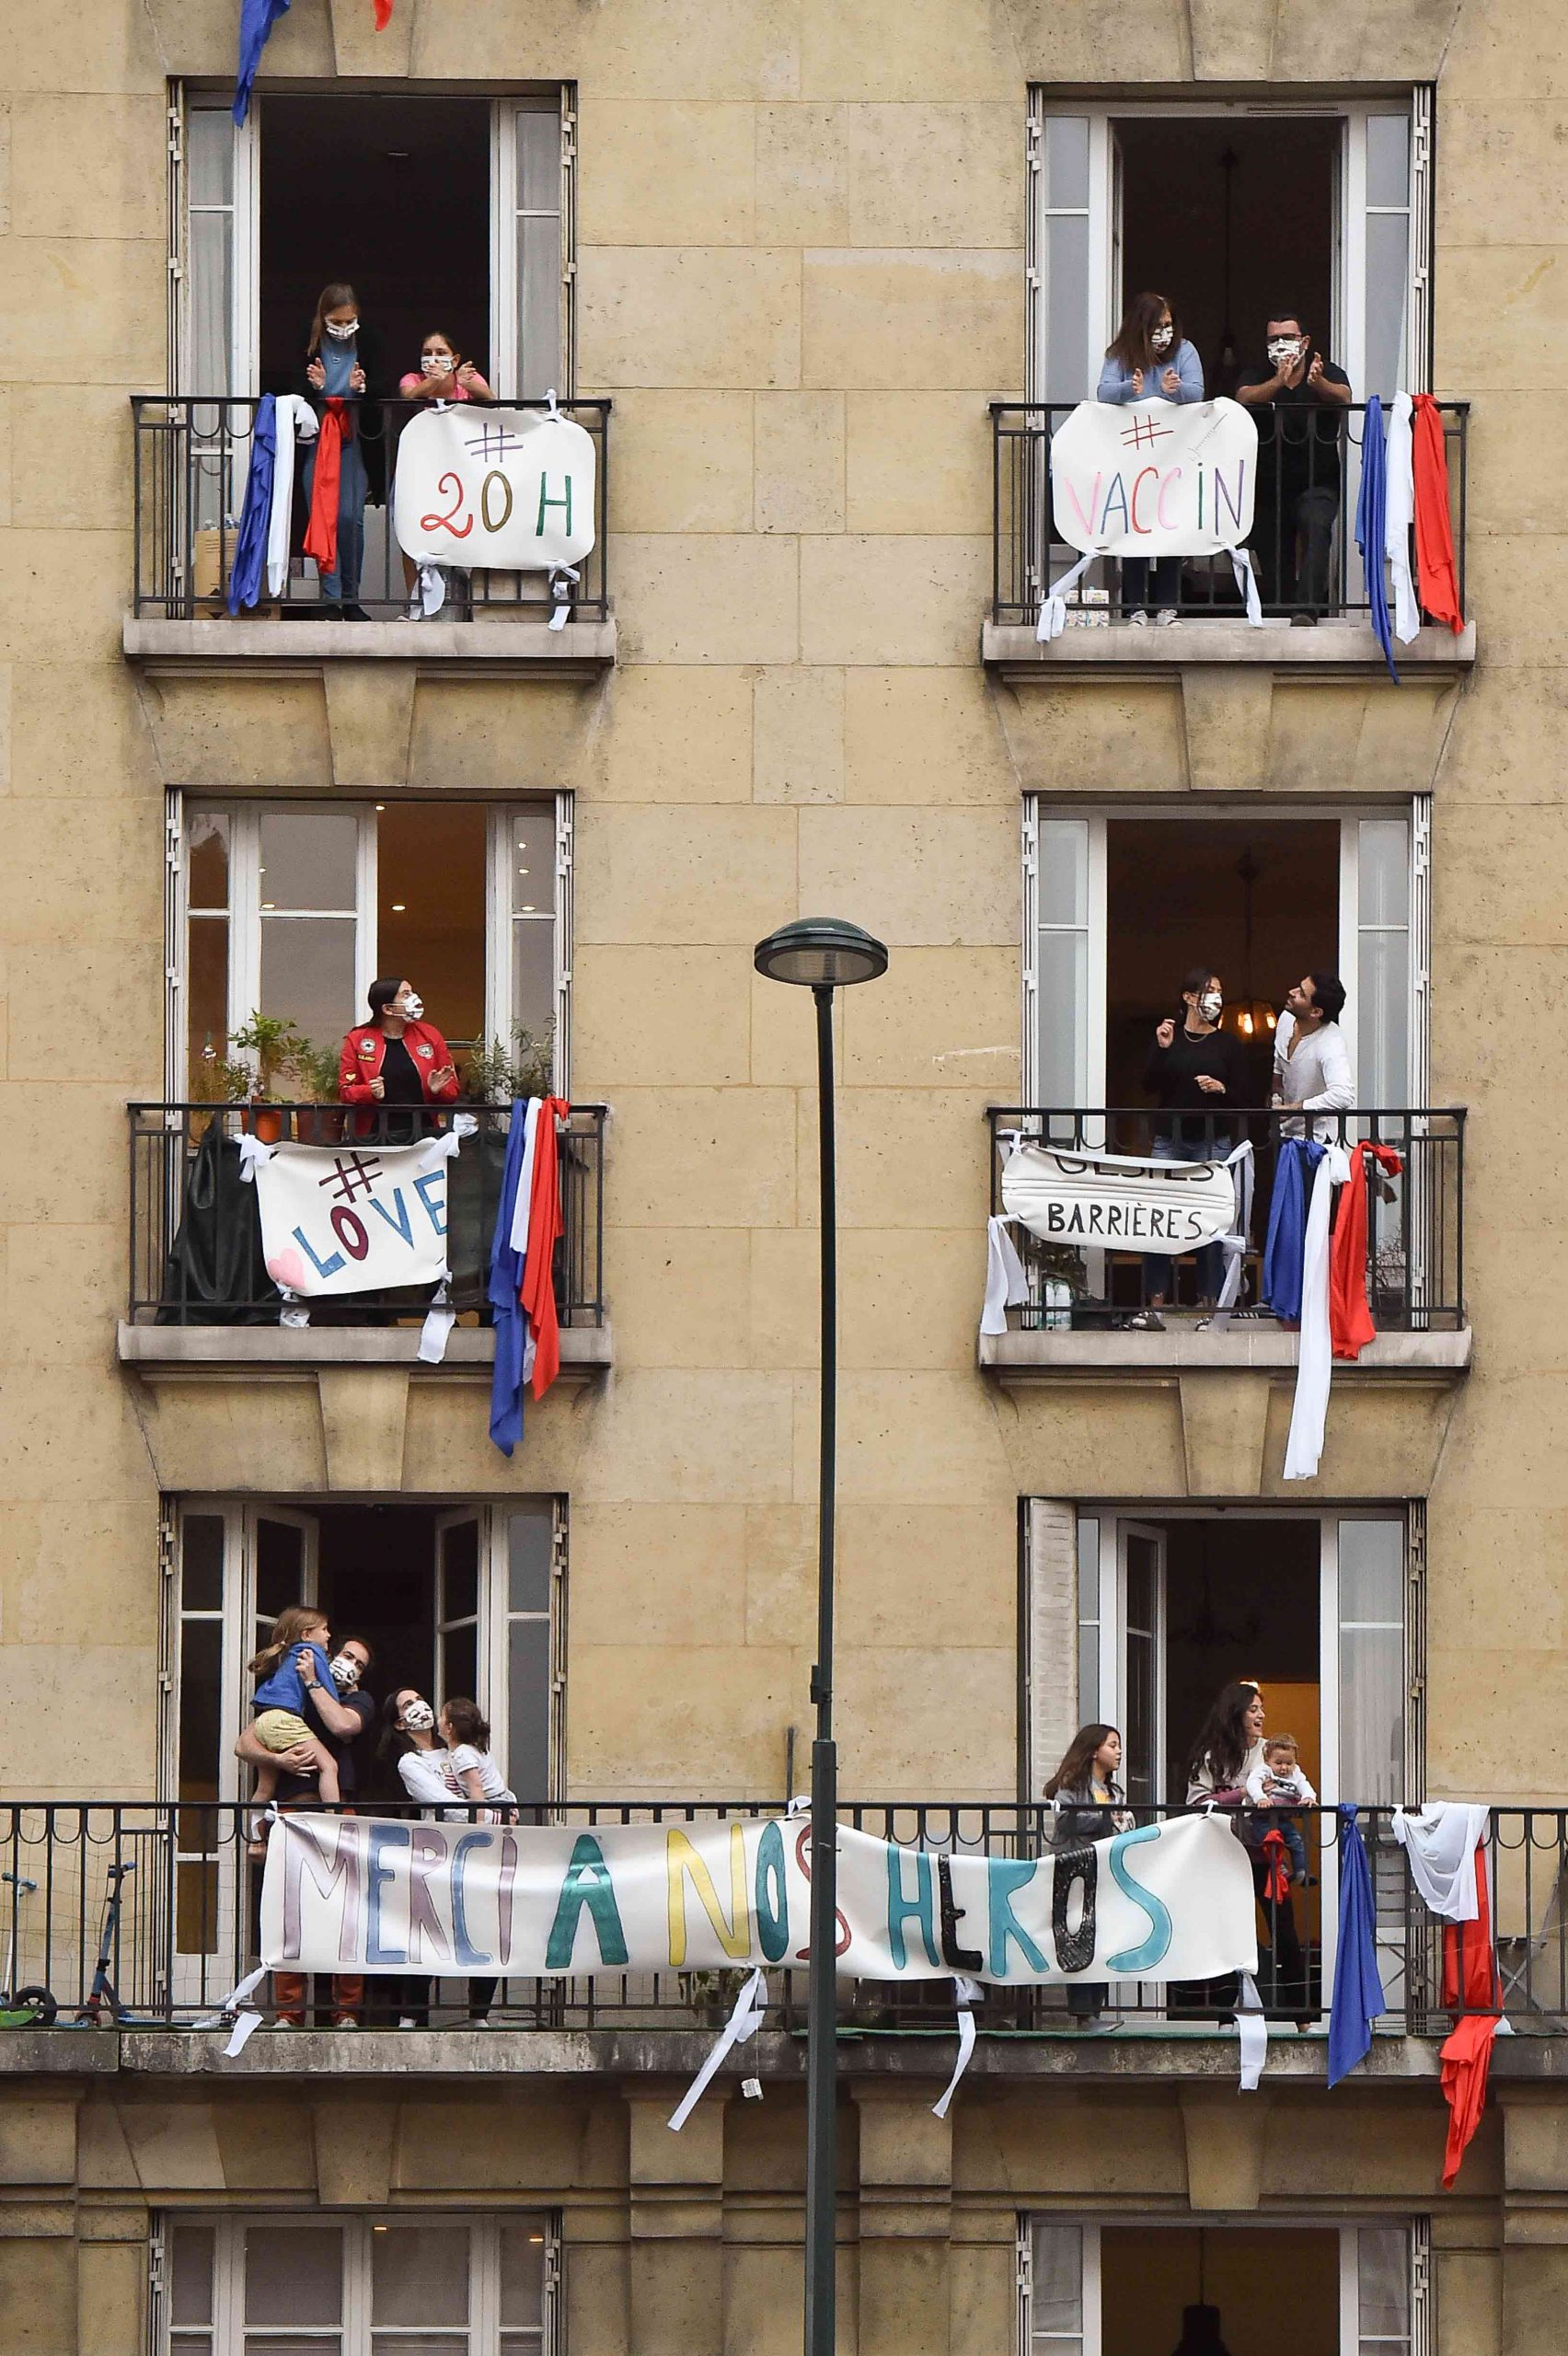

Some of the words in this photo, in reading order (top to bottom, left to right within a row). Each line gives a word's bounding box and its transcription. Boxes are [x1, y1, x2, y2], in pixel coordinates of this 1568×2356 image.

[464, 422, 524, 463] #
[1120, 414, 1174, 450] #
[420, 470, 513, 538] 20
[536, 471, 572, 537] H
[318, 1151, 384, 1204] #
[292, 1169, 447, 1278] LOVE
[545, 1833, 629, 1969] A
